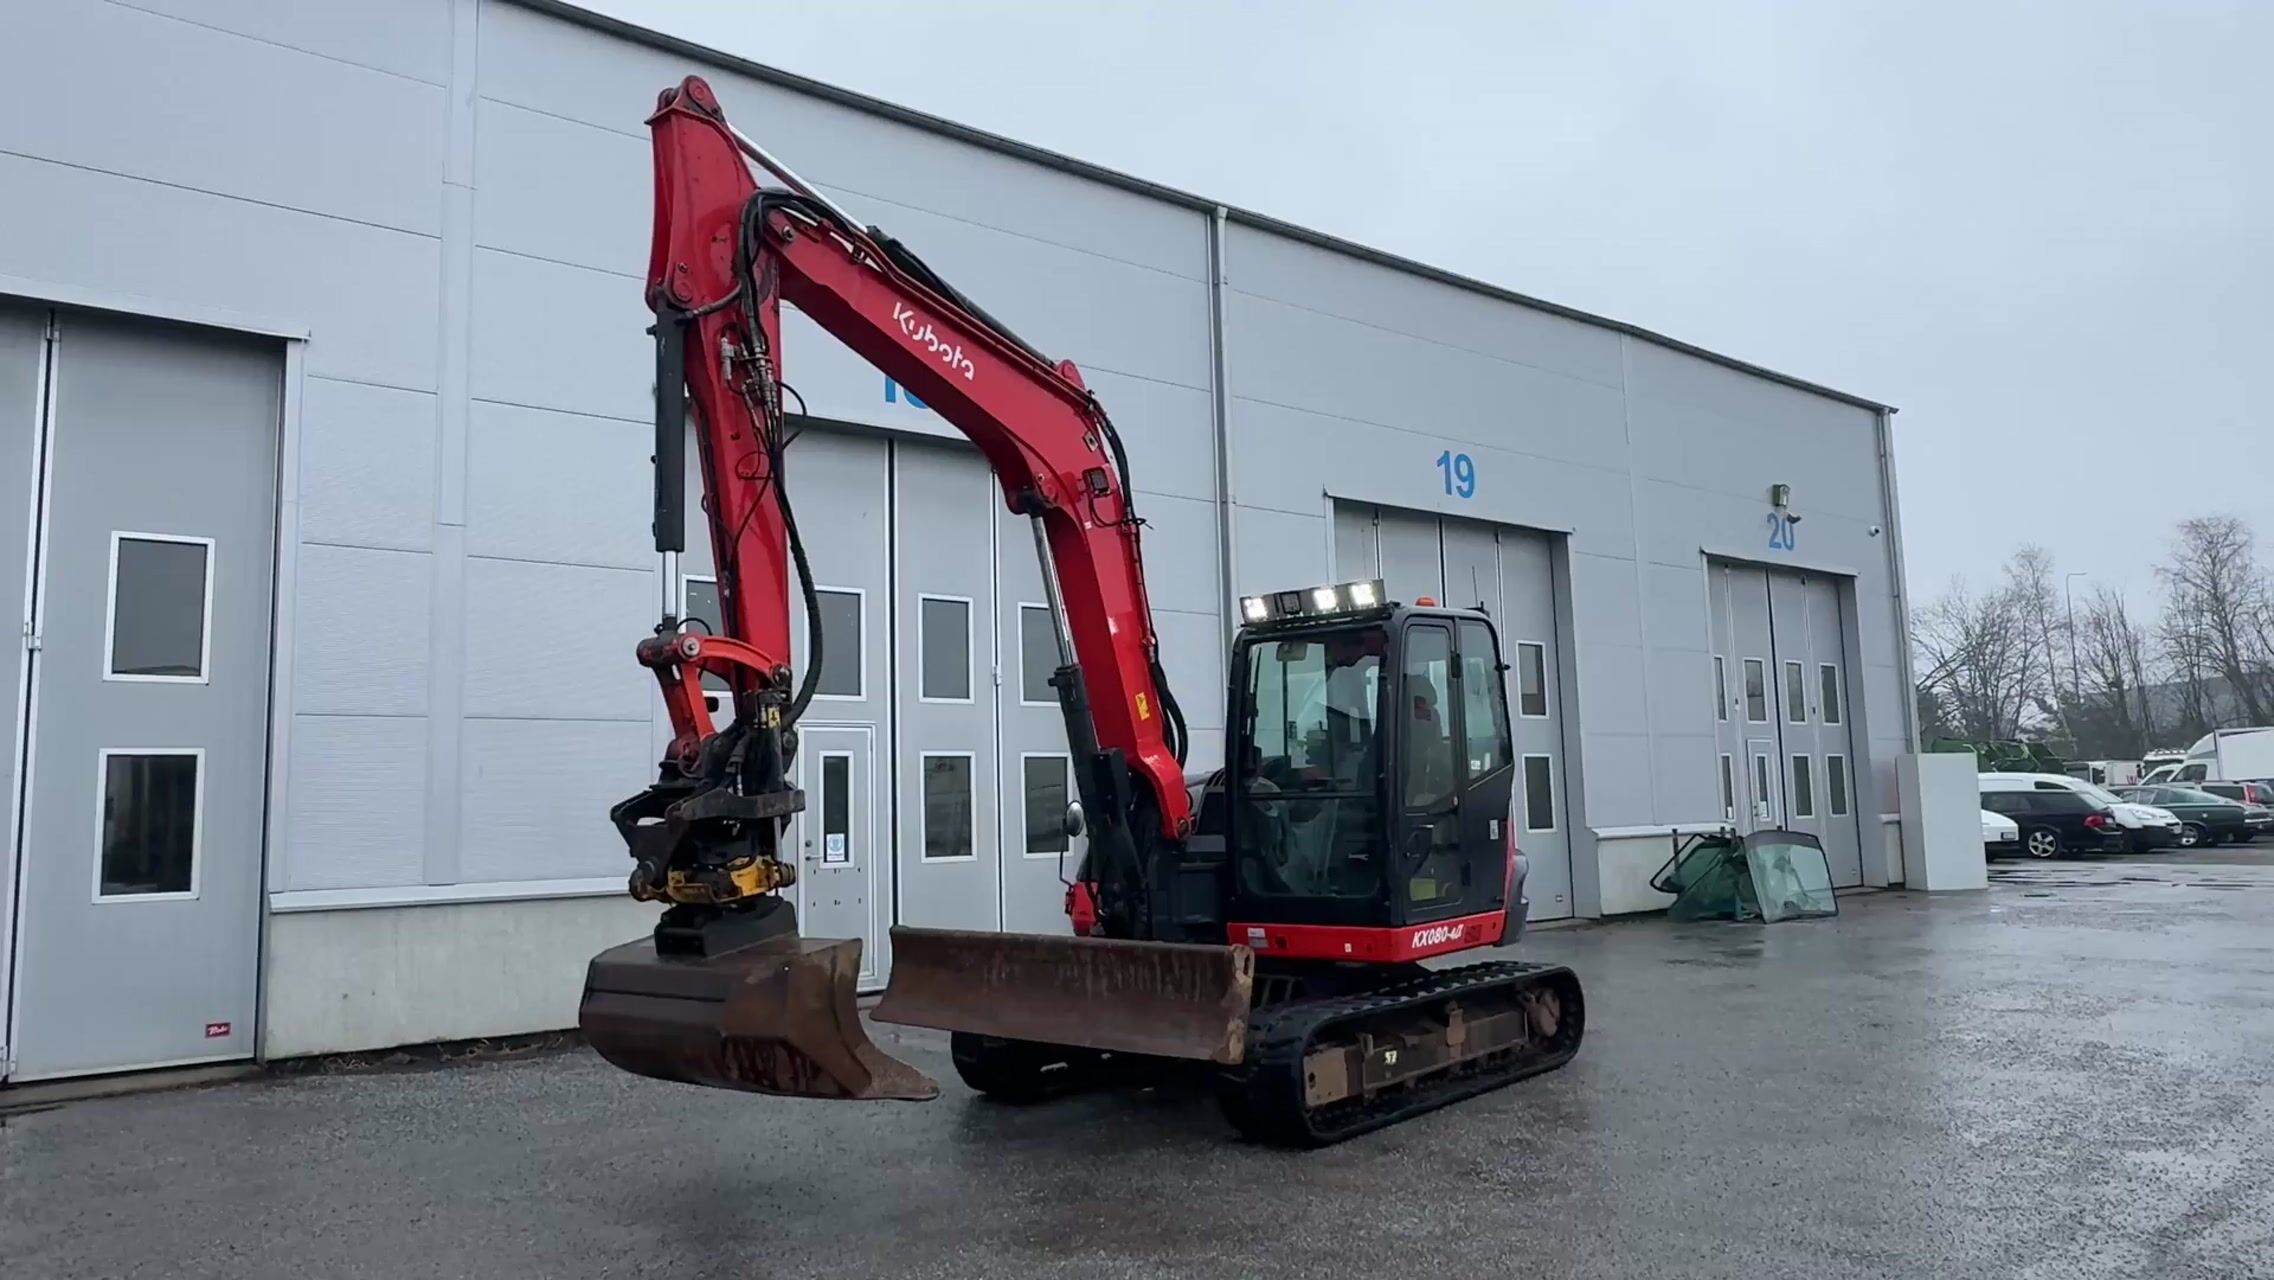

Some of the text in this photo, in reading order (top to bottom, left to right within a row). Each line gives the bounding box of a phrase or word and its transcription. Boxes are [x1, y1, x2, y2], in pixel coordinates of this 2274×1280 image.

[893, 302, 975, 380] Kubota
[1436, 450, 1475, 498] 19
[1766, 512, 1795, 551] 20
